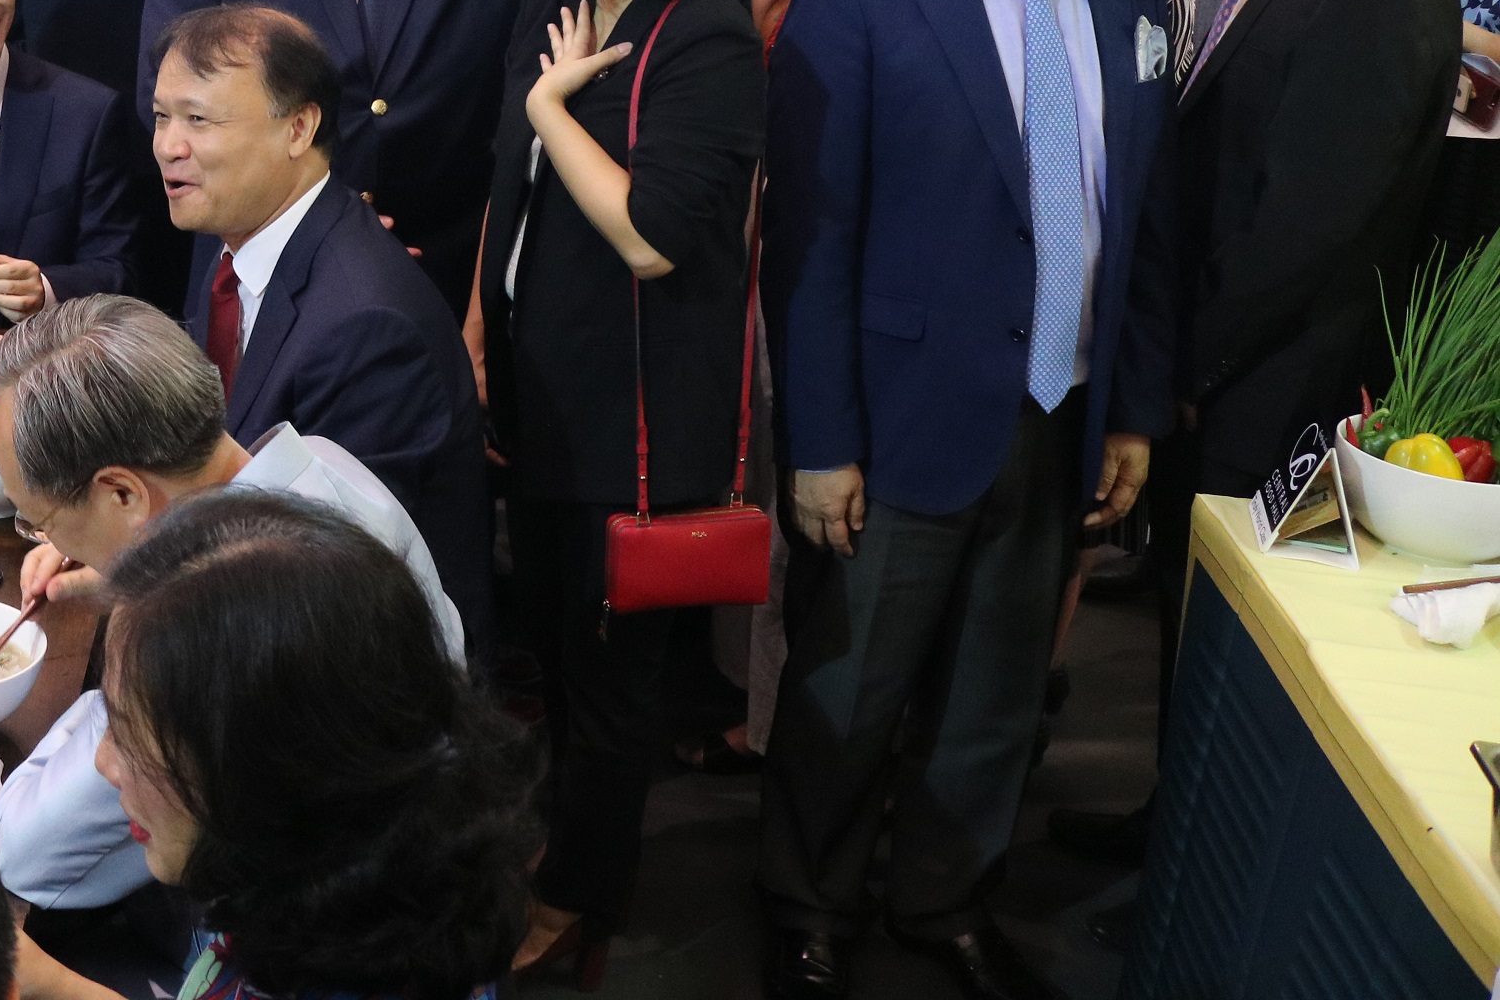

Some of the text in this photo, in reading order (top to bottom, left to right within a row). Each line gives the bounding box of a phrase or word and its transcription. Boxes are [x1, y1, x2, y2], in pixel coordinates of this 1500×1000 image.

[1264, 479, 1281, 525] FOOD HALL
[1271, 468, 1289, 514] CENTRAL
